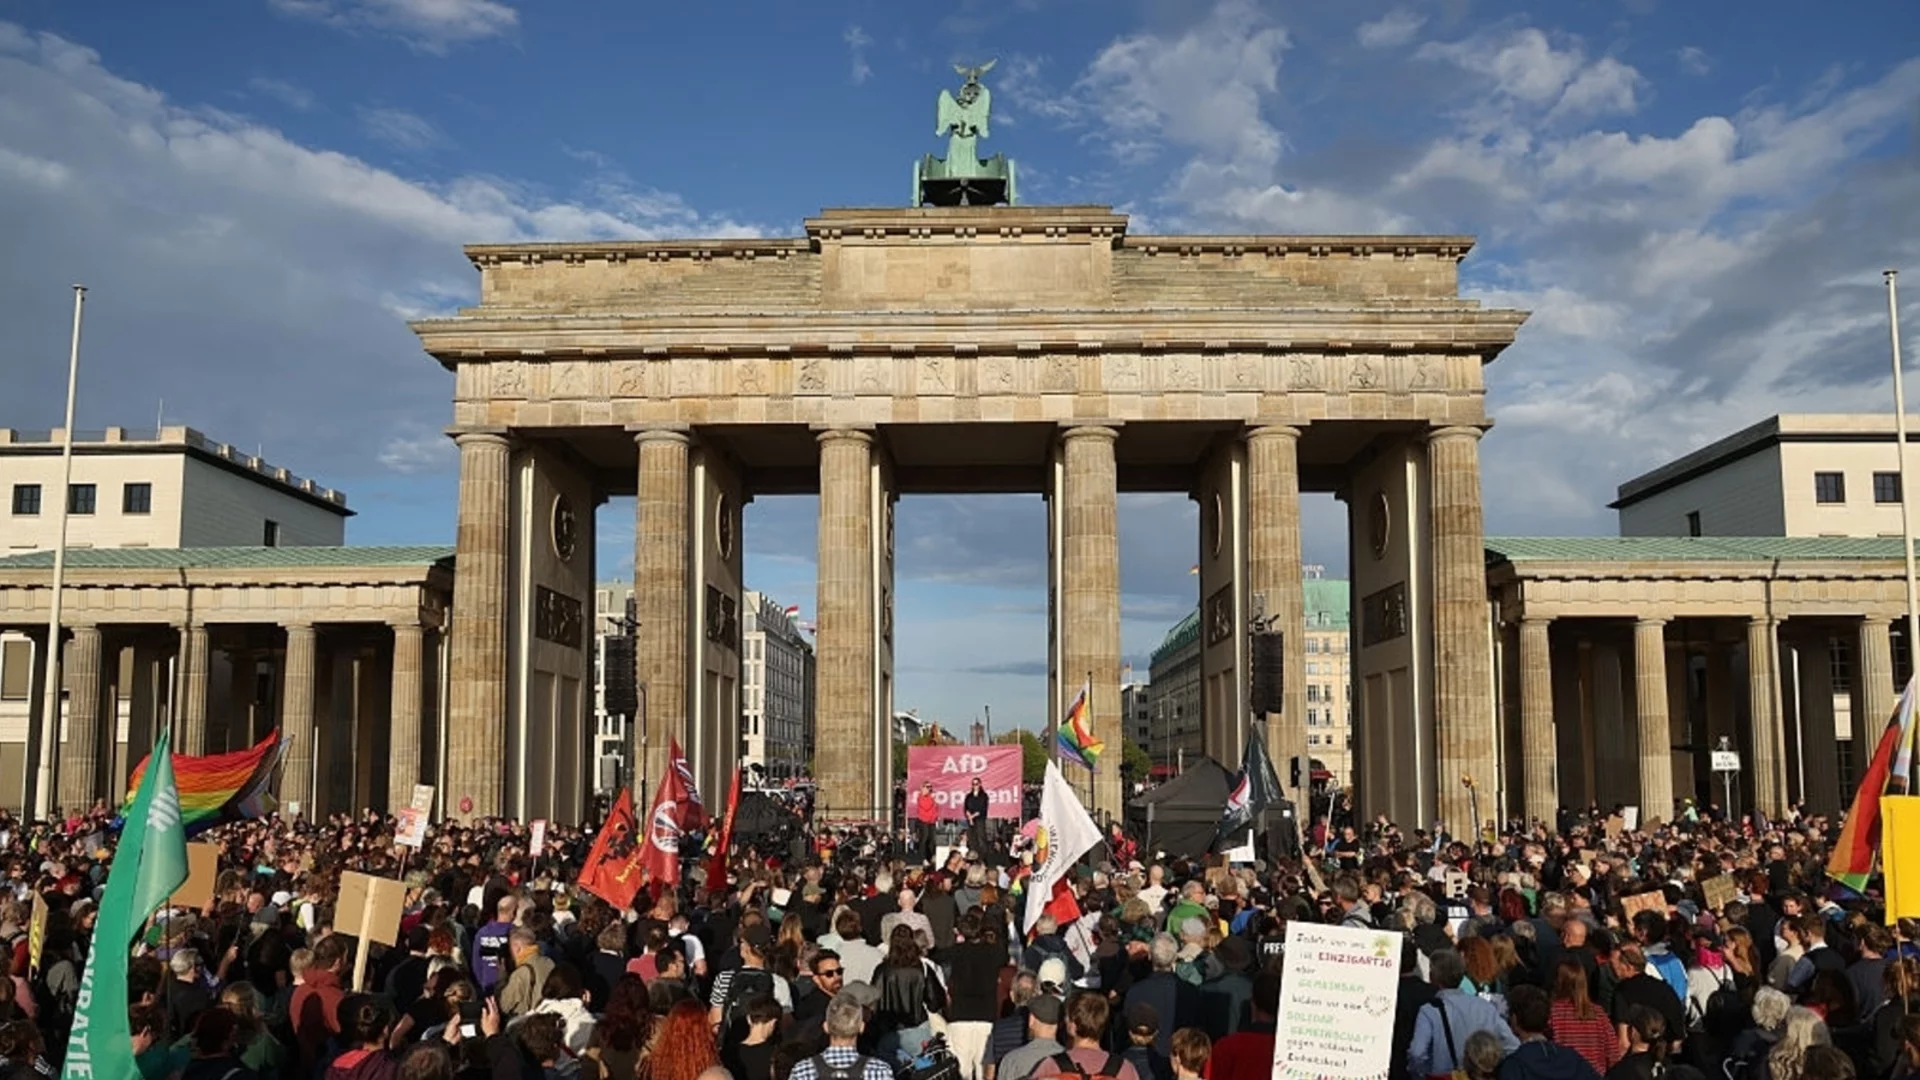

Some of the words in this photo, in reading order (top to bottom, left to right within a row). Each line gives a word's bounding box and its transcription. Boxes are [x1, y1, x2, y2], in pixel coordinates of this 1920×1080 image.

[941, 754, 988, 774] AfD
[1318, 952, 1393, 968] EINZIGARTIG
[1298, 979, 1365, 993] GEMEINSAM
